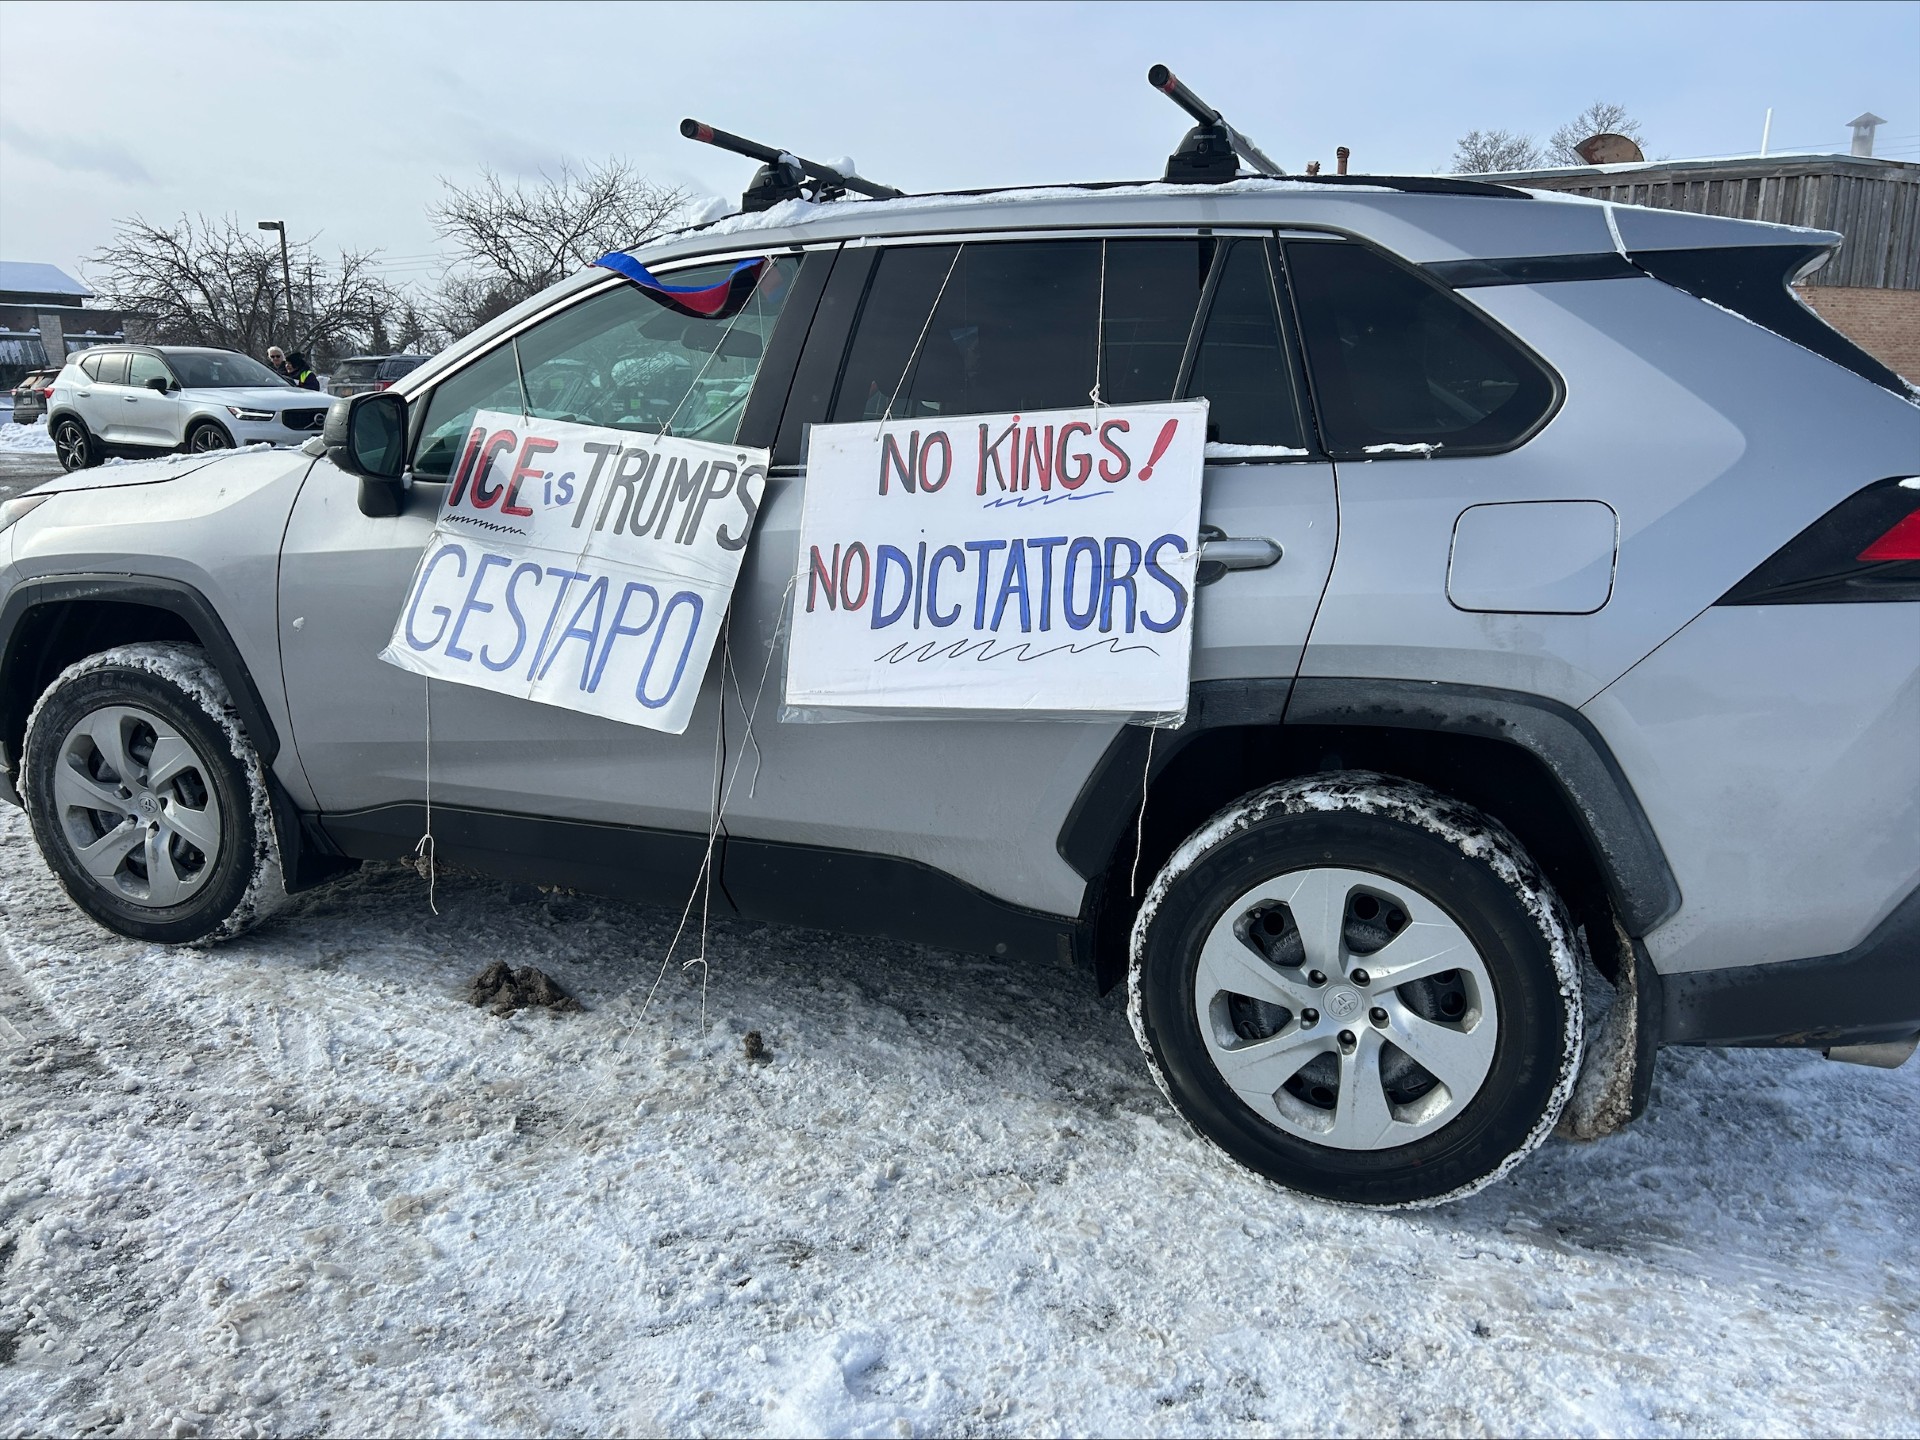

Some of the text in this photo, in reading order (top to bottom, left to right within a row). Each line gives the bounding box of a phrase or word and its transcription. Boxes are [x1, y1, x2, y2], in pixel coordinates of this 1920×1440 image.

[448, 427, 559, 517] ICE
[571, 442, 768, 551] TRUMP'S
[878, 430, 952, 496] NO
[806, 541, 870, 613] NO
[405, 544, 704, 710] GESTAPO
